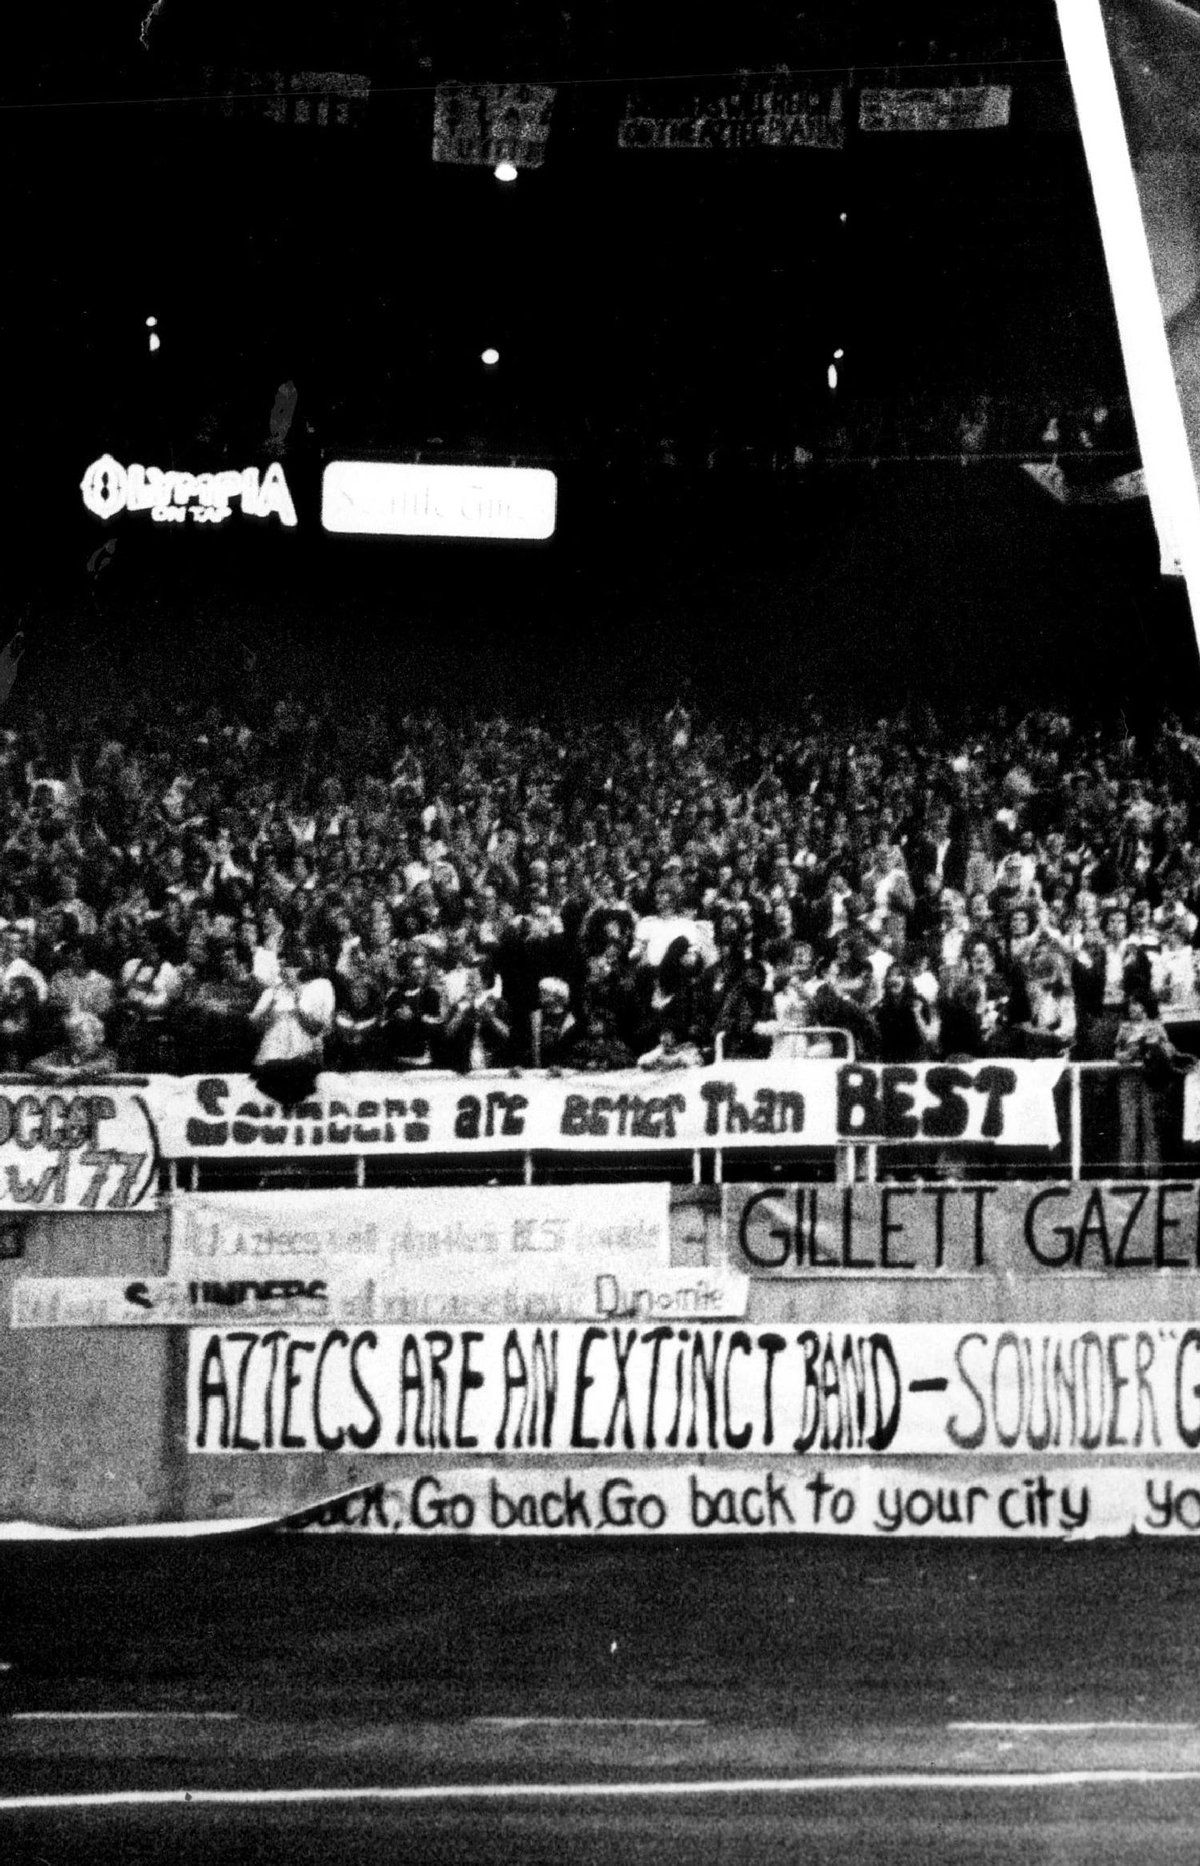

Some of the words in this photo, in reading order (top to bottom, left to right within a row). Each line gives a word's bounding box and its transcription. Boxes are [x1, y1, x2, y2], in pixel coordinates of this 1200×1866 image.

[836, 1064, 1018, 1138] BEST
[739, 1186, 998, 1269] GILLETT
[196, 1329, 381, 1451] AZTECS
[396, 1331, 485, 1449] ARE
[496, 1328, 560, 1450] AN
[793, 1330, 900, 1452] BAND
[410, 1475, 475, 1528] Go
[691, 1473, 796, 1530] back
[805, 1472, 856, 1524] to
[873, 1486, 990, 1533] your
[1000, 1475, 1091, 1530] city
